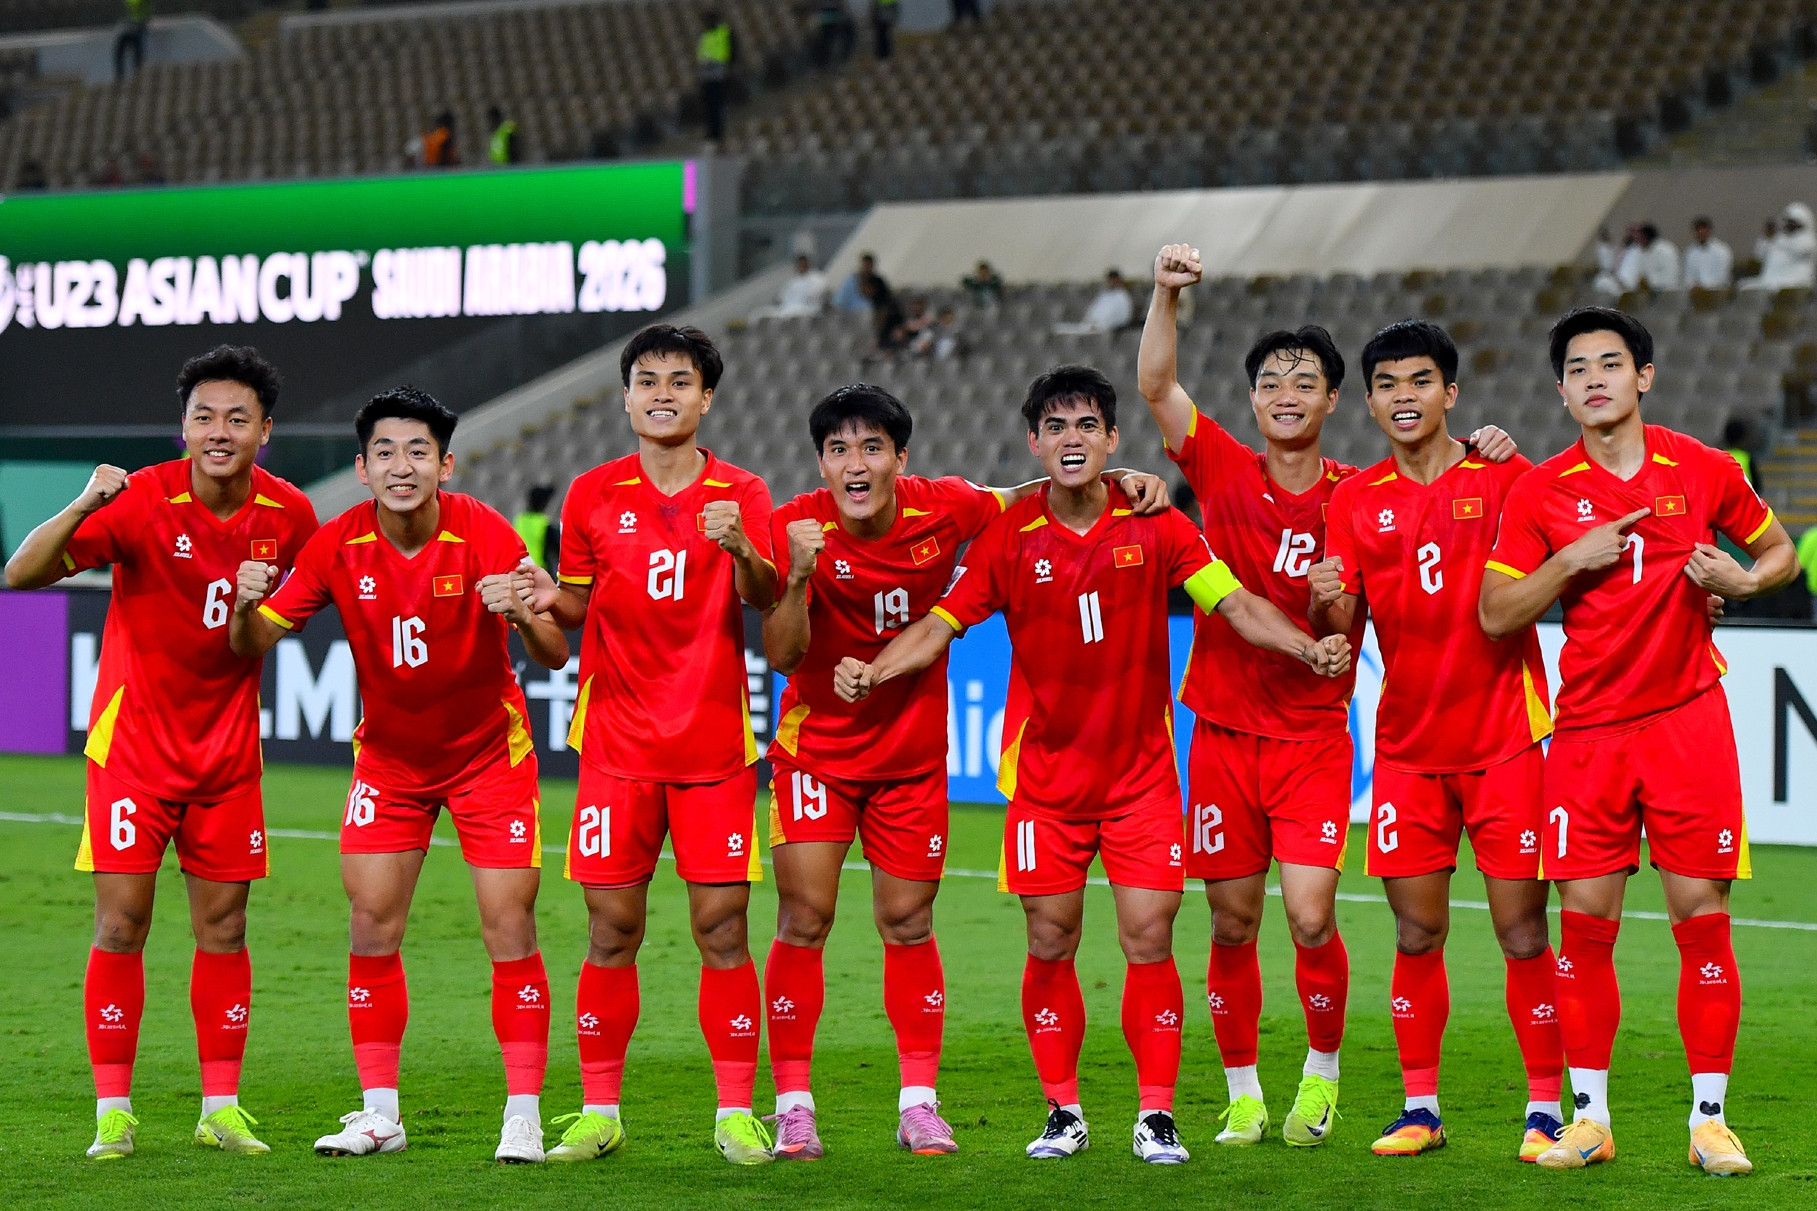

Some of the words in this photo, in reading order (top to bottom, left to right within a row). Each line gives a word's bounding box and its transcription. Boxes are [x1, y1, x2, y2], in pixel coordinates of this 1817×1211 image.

[34, 260, 118, 329] U23
[117, 254, 262, 326] ASIAN
[257, 251, 359, 323] CUP
[577, 238, 667, 312] 2026
[647, 549, 686, 601] 21
[1273, 528, 1316, 577] 12
[1418, 541, 1443, 595] 2
[1622, 531, 1644, 584] 7
[203, 577, 232, 629] 6
[874, 587, 909, 635] 19
[1078, 590, 1104, 644] 11
[392, 615, 429, 669] 16
[345, 778, 380, 827] 16
[792, 770, 828, 821] 19
[110, 797, 137, 851] 6
[579, 804, 610, 859] 21
[1017, 819, 1037, 872] 11
[1193, 803, 1225, 855] 12
[1377, 801, 1399, 854] 2
[1549, 805, 1569, 859] 7
